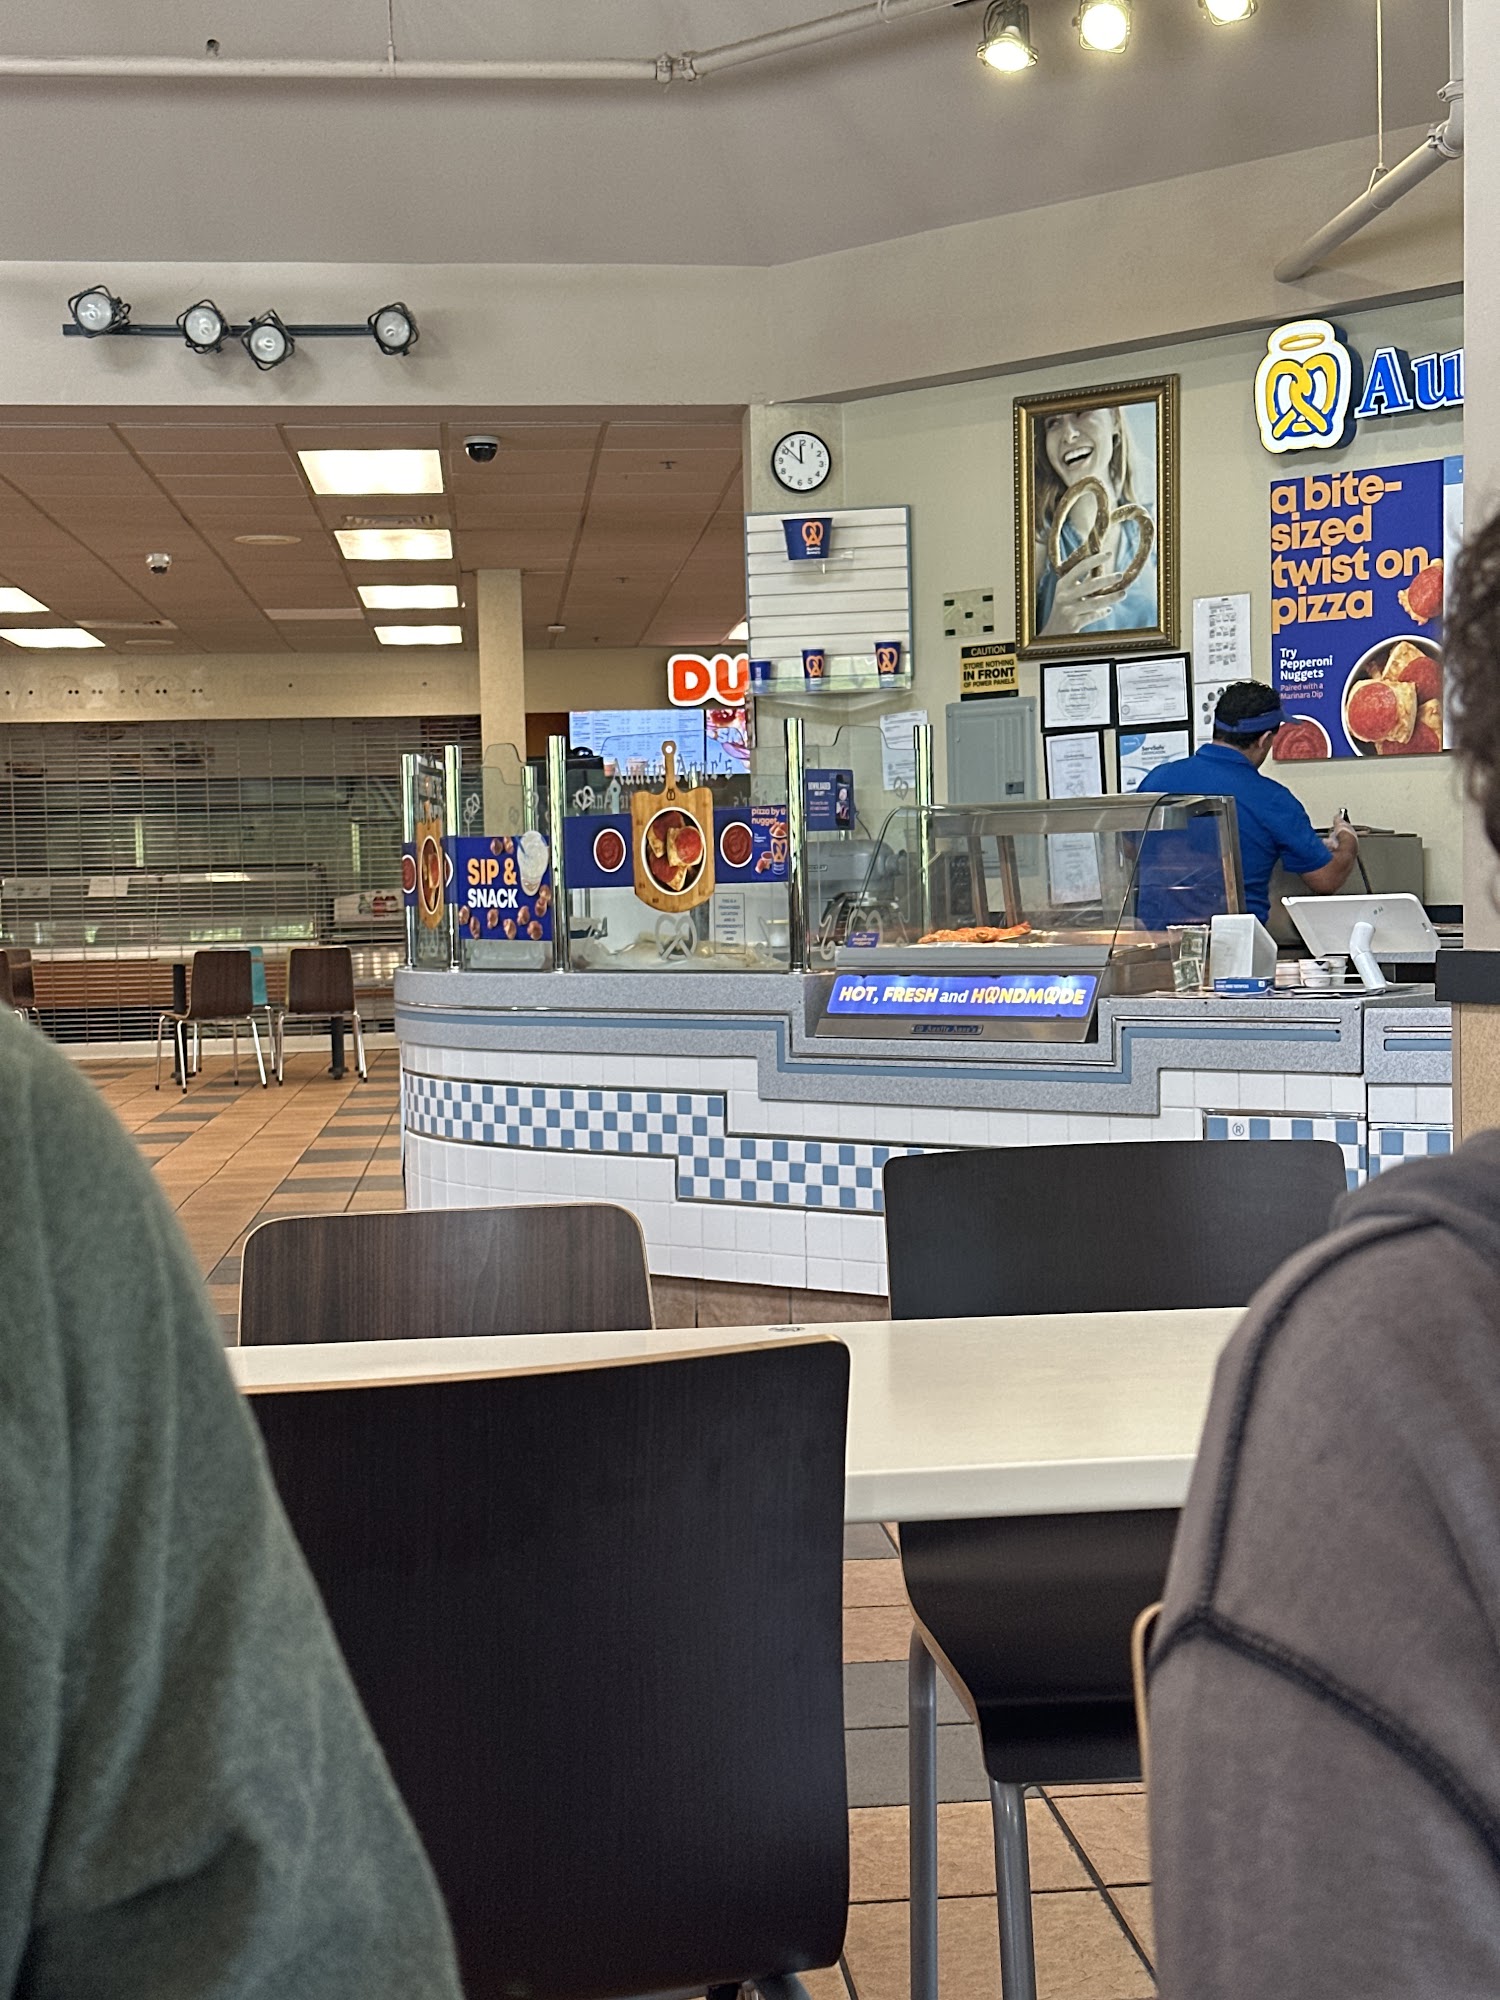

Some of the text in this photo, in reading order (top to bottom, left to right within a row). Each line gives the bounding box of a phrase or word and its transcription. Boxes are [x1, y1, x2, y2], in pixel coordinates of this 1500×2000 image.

[1271, 471, 1403, 515] a bite-
[1271, 505, 1373, 552] sized
[1271, 546, 1429, 588] twist on
[1271, 586, 1373, 635] pizza
[970, 645, 1006, 657] CAUTION
[1280, 648, 1297, 660] Try
[963, 659, 1015, 670] STORE NOTHING
[1280, 655, 1333, 671] Pepperoni
[963, 667, 1015, 681] IN FRONT
[1280, 669, 1324, 682] Nuggets
[1281, 683, 1301, 691] Paired
[1303, 682, 1318, 690] with
[1311, 691, 1323, 699] Dip
[770, 807, 780, 818] by
[468, 858, 518, 886] SIP &
[467, 888, 519, 909] SNACK
[838, 986, 879, 1005] HOT,
[882, 987, 940, 1003] FRESH
[939, 989, 968, 1004] and
